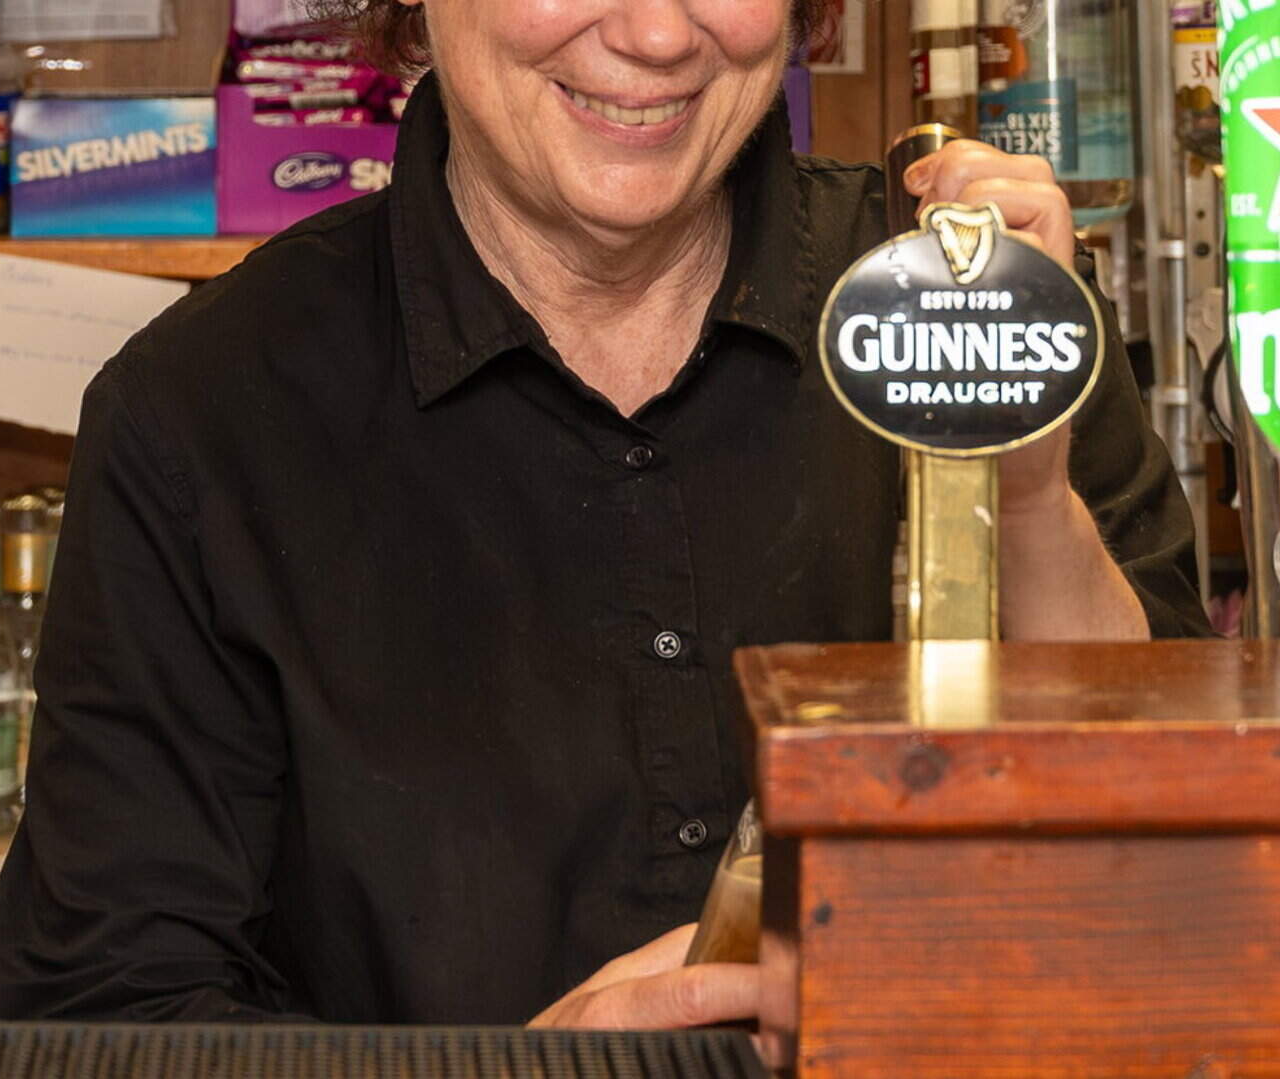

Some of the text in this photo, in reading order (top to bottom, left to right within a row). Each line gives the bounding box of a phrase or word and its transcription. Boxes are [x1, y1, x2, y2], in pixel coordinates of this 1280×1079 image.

[16, 121, 210, 184] SILVERMINTS
[837, 312, 1082, 372] GUINNESS
[886, 381, 1046, 405] DRAUGHT
